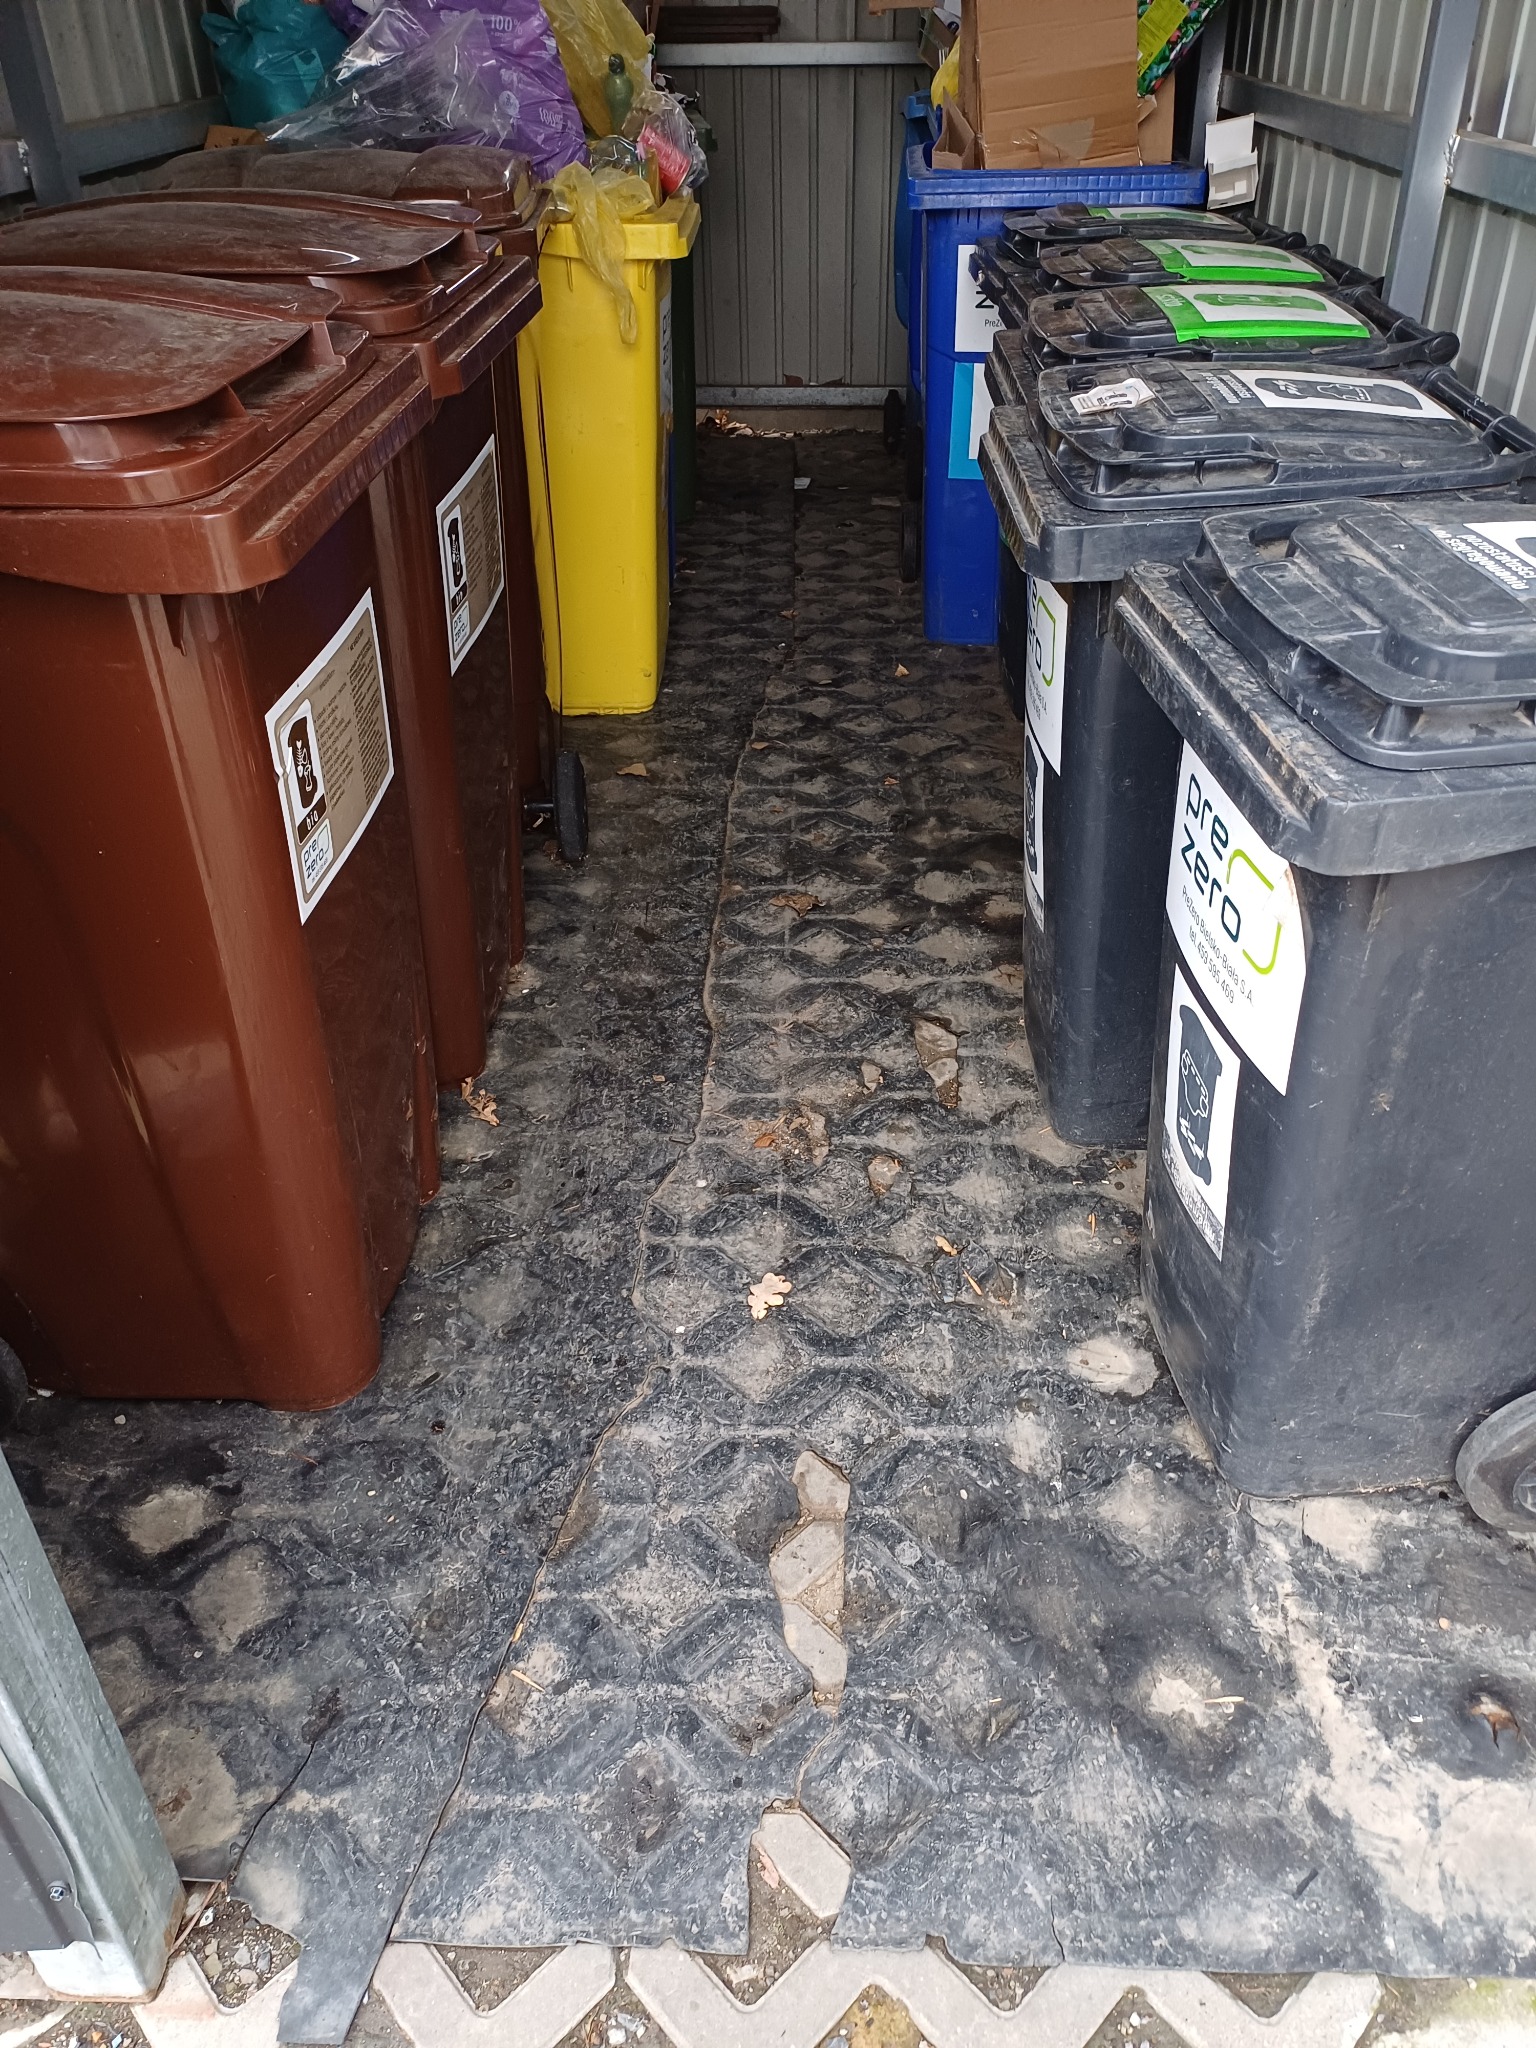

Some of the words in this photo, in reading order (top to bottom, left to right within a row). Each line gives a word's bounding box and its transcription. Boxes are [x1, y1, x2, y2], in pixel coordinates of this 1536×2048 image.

[1445, 538, 1530, 590] segregowaniu
[306, 809, 319, 831] bio
[1186, 772, 1229, 862] pre
[303, 838, 317, 868] pre
[305, 847, 325, 880] zero
[1181, 822, 1242, 943] zero
[1182, 884, 1200, 926] PreZero
[1197, 941, 1209, 965] 453
[1208, 958, 1221, 984] 595
[1220, 979, 1235, 1004] 469
